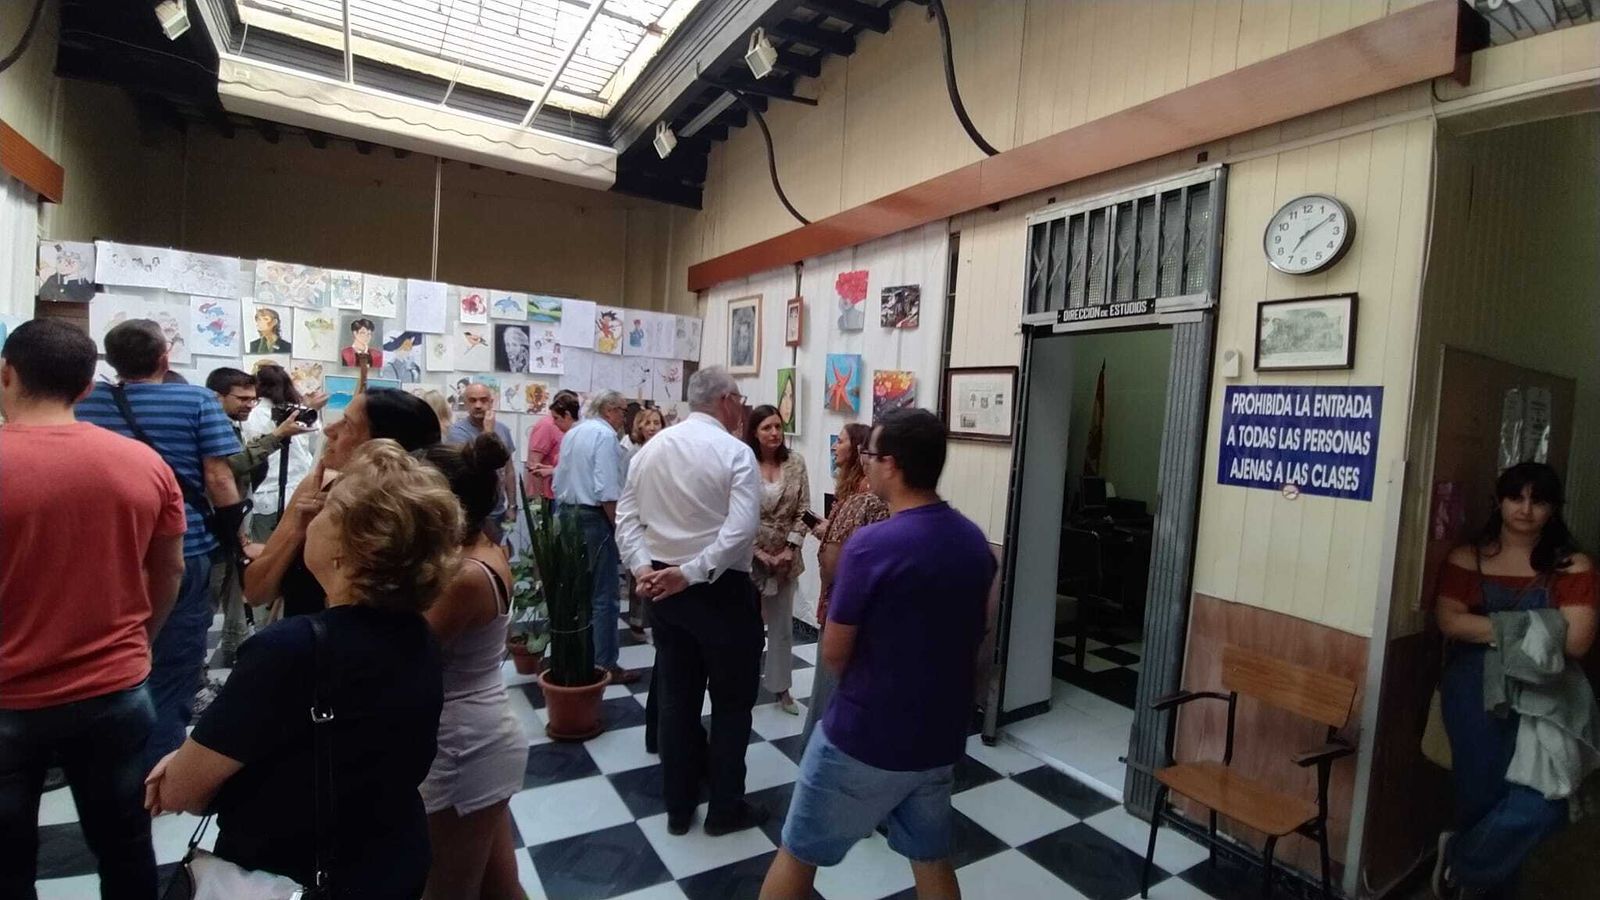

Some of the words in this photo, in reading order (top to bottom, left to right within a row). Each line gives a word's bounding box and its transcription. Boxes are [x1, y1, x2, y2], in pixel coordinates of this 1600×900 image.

[1290, 211, 1298, 219] 11
[1303, 205, 1313, 214] 12
[1279, 223, 1289, 231] 10
[1063, 306, 1101, 322] DIRECCION
[1109, 301, 1147, 316] ESTUDIOS
[1231, 393, 1292, 416] PROHIBIDA
[1294, 394, 1310, 416] LA
[1313, 395, 1372, 419] ENTRADA
[1226, 425, 1235, 446] A
[1239, 425, 1276, 449] TODAS
[1278, 428, 1301, 451] LAS
[1303, 429, 1371, 455] PERSONAS
[1230, 457, 1272, 482] AJENAS
[1273, 461, 1283, 483] A
[1286, 462, 1309, 486] LAS
[1311, 464, 1360, 491] CLASES
